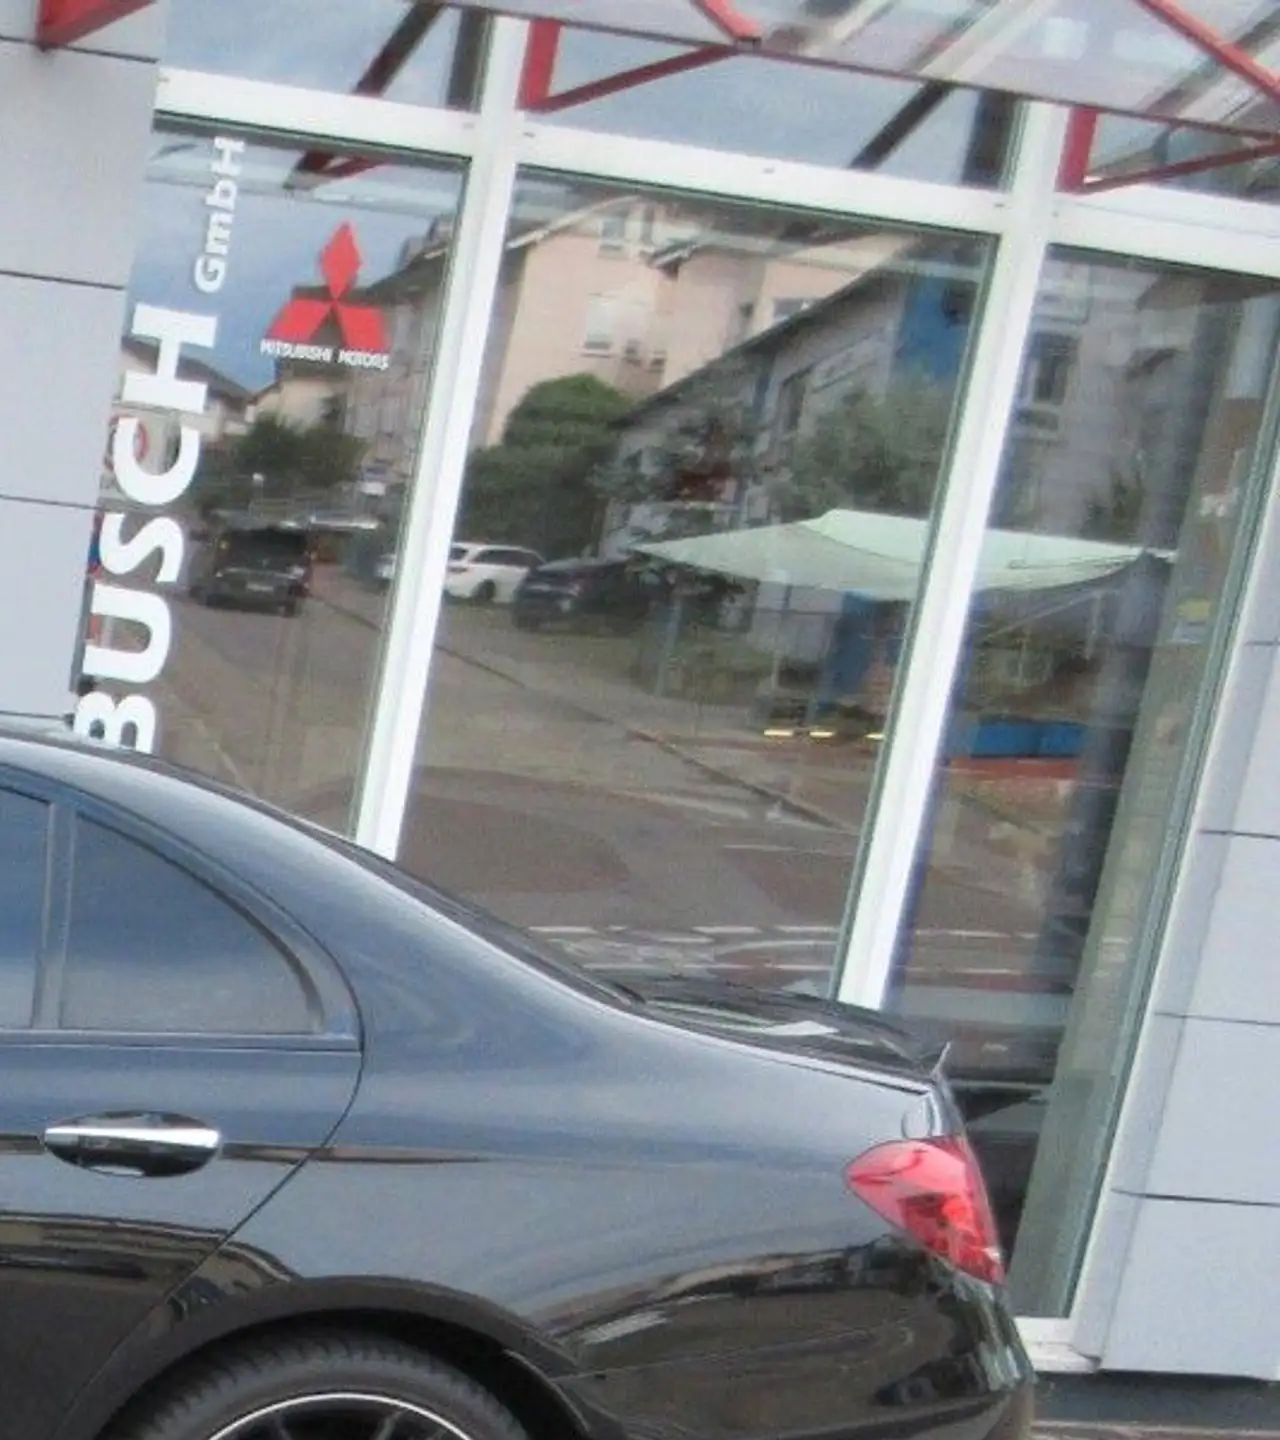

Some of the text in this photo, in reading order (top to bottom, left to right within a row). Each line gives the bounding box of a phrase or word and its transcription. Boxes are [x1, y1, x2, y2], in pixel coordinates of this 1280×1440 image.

[73, 136, 245, 754] BUSCH GmbH
[259, 338, 389, 371] MITSUBISHI MOTORS
